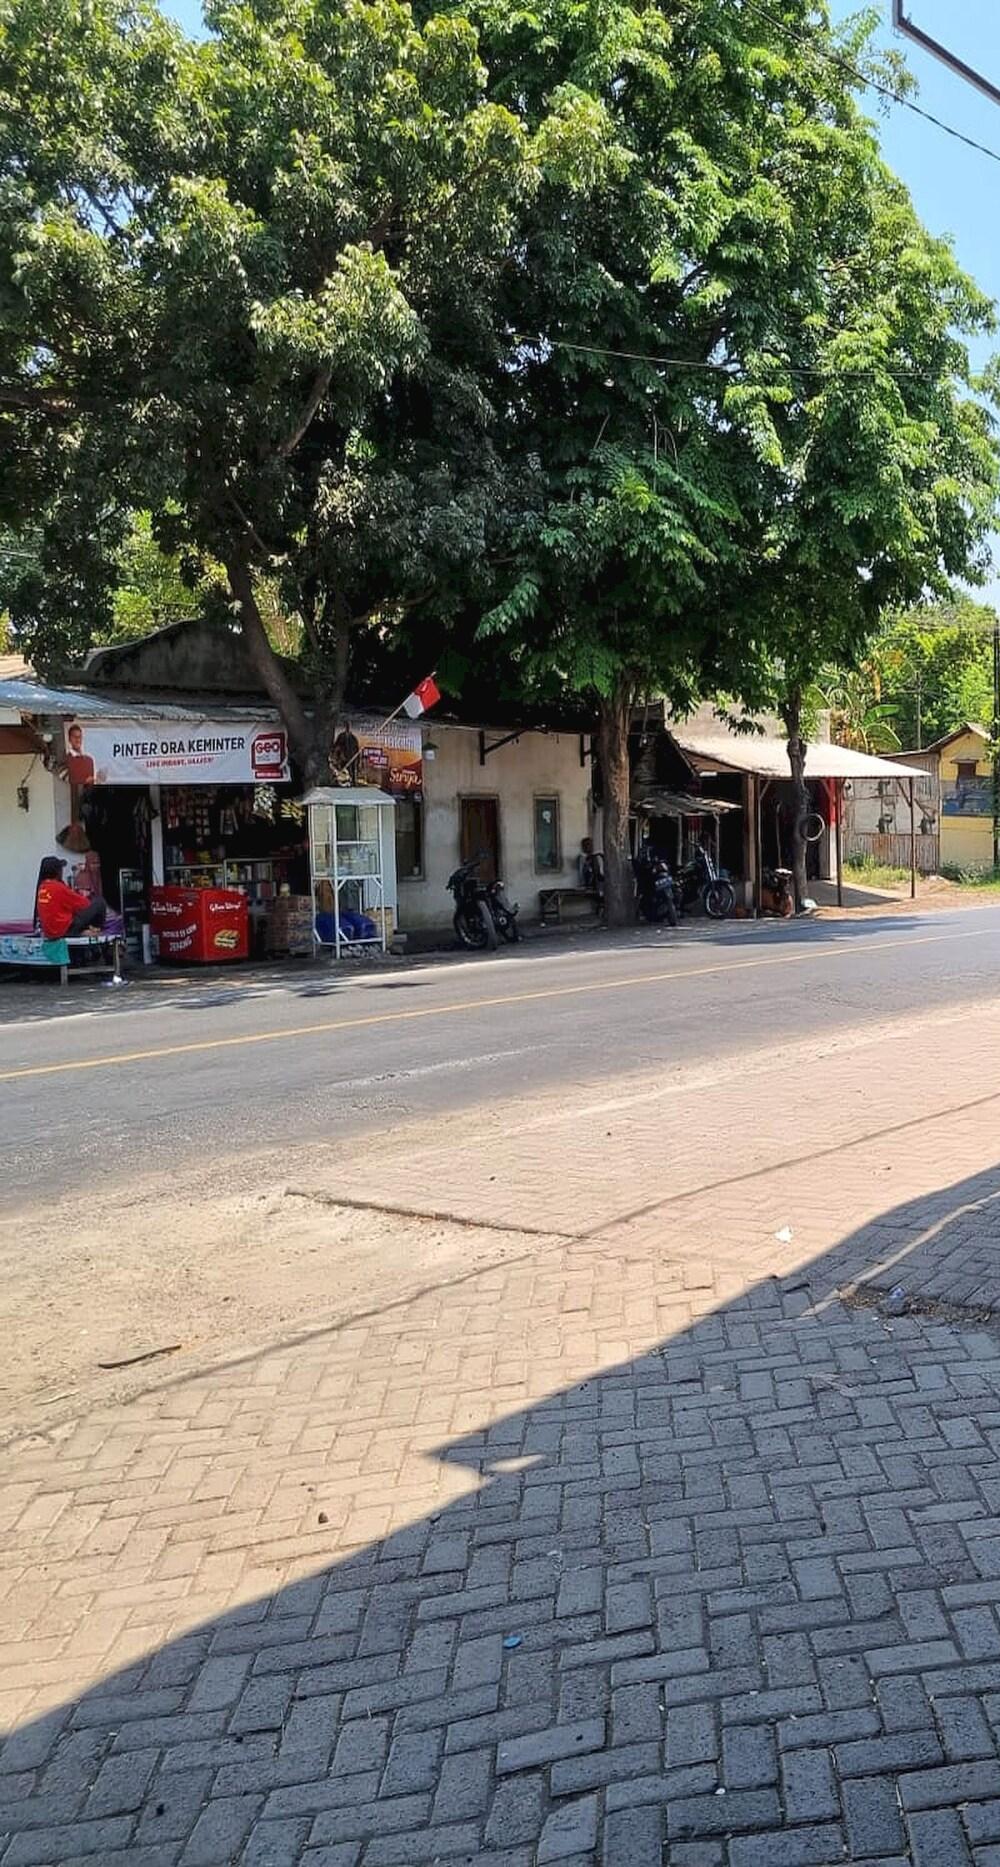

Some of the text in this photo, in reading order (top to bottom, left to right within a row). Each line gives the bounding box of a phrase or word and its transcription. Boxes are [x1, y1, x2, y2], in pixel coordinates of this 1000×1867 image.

[113, 737, 245, 757] PINTER ORA KEMINTER
